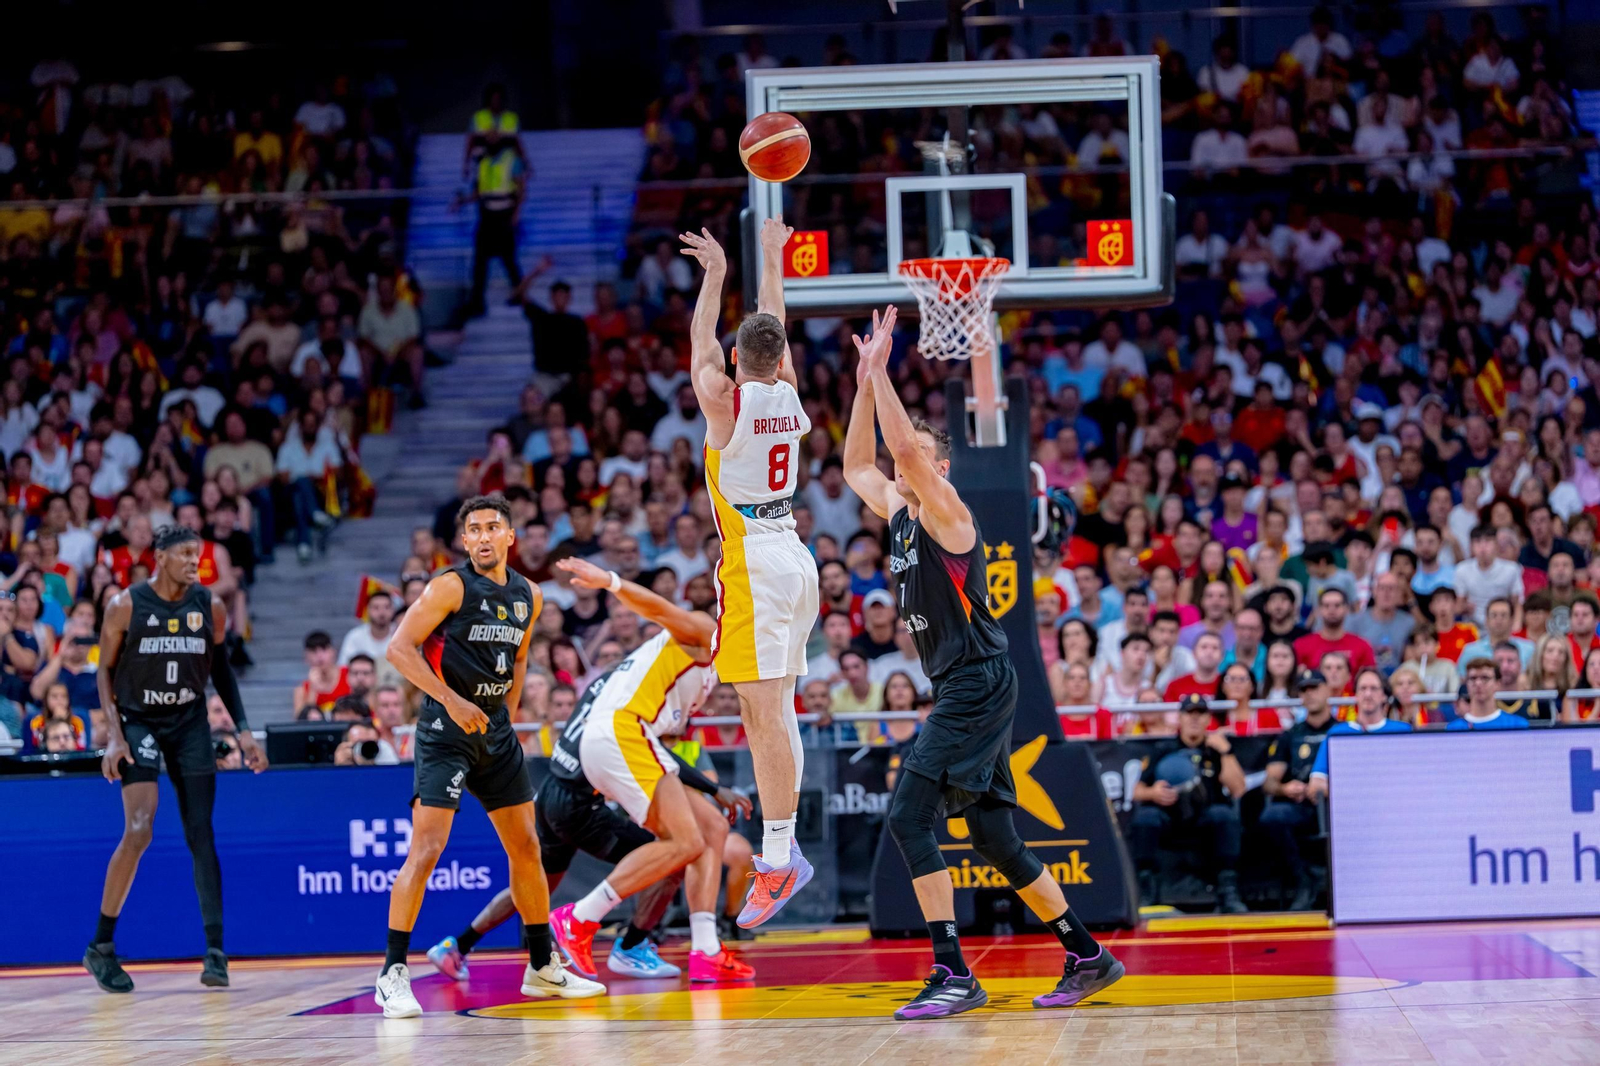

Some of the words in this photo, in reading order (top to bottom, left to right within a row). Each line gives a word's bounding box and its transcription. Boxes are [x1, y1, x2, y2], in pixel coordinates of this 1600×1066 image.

[754, 415, 801, 435] BRIZUELA
[768, 443, 790, 492] 8
[166, 661, 179, 684] 0
[495, 652, 507, 674] 4
[143, 689, 177, 705] ING
[474, 683, 505, 696] ING
[1469, 835, 1548, 885] hm
[298, 864, 343, 895] hm
[351, 860, 491, 893] hostales
